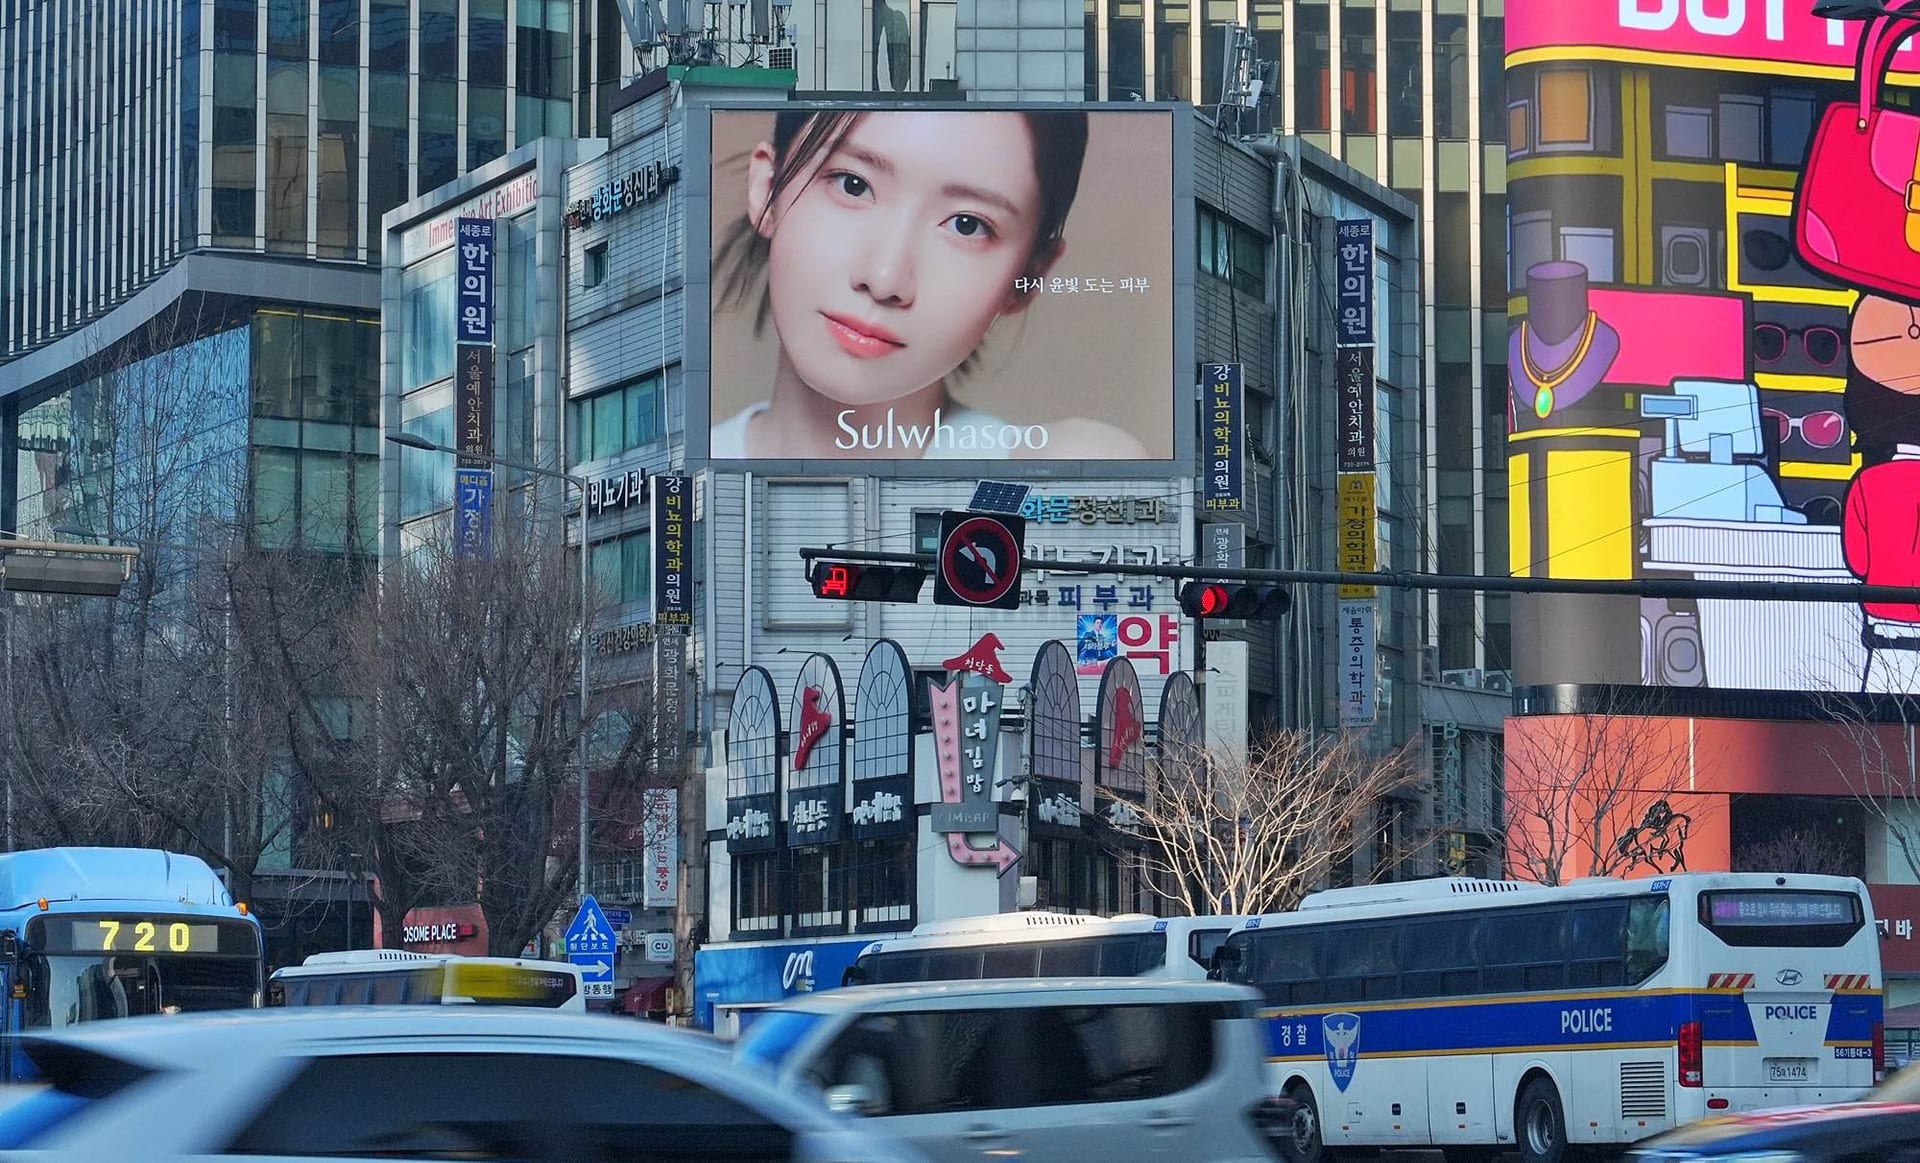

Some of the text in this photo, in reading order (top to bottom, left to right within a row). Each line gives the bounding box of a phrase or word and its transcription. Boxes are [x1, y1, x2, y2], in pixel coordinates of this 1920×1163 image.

[460, 224, 492, 237] 세종로
[1339, 225, 1371, 238] 세종로
[462, 243, 489, 334] 한의원
[1014, 277, 1150, 293] 다시 윤빛 도는 피부
[1341, 243, 1368, 335] 한의원
[466, 349, 483, 443] 서울예안치과
[1347, 351, 1365, 446] 서울예안치과
[835, 408, 1049, 450] Sulwhasoo
[590, 467, 643, 515] 비뇨기과
[1206, 497, 1240, 510] 피부과
[1058, 585, 1155, 611] 피부과
[658, 612, 691, 625] 피부과
[1118, 615, 1178, 675] 약
[1349, 617, 1365, 705] 통증의학과
[963, 690, 996, 794] 마녀김밥
[938, 811, 990, 824] IMBAP
[99, 921, 190, 952] 720
[431, 923, 457, 941] PLACE
[570, 942, 609, 951] 횡단보도
[1561, 1007, 1612, 1034] POLICE
[1765, 1005, 1817, 1020] POLICE
[1281, 1023, 1308, 1047] 경찰
